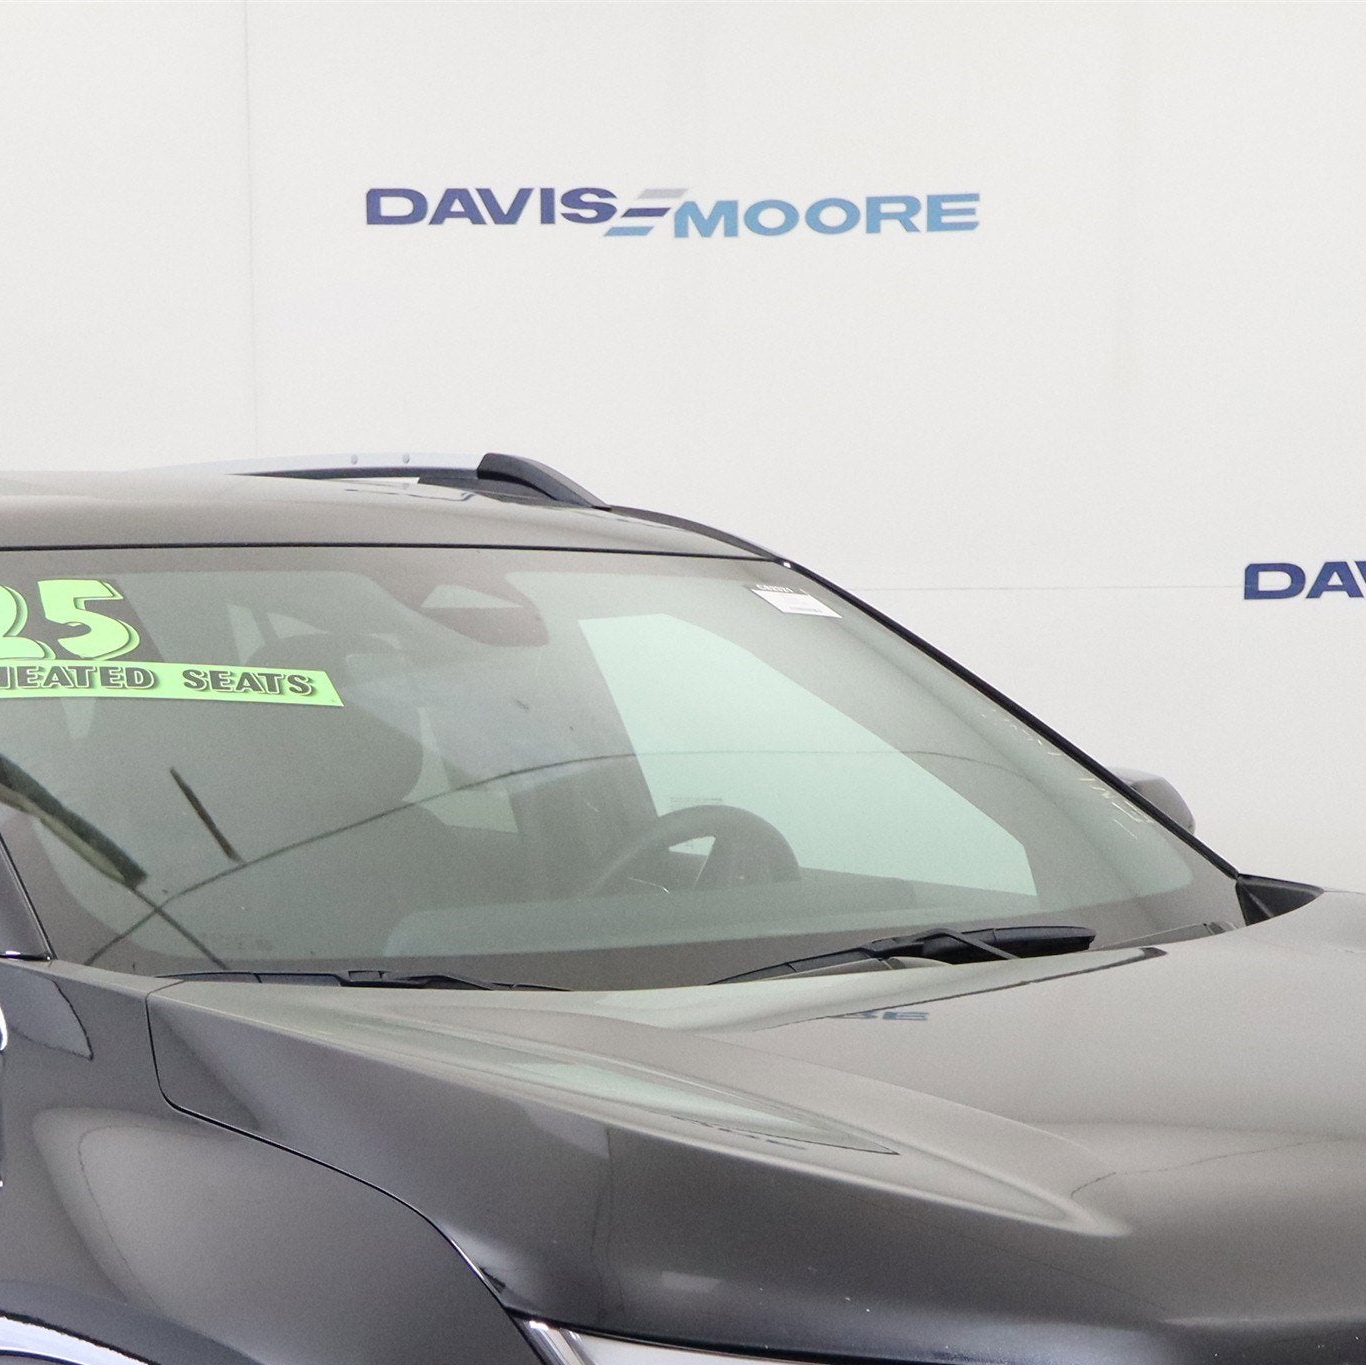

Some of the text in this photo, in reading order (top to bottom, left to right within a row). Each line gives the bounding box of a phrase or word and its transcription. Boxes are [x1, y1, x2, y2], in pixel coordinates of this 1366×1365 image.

[366, 187, 981, 238] DAVIS MOORE
[182, 668, 317, 696] SEATS
